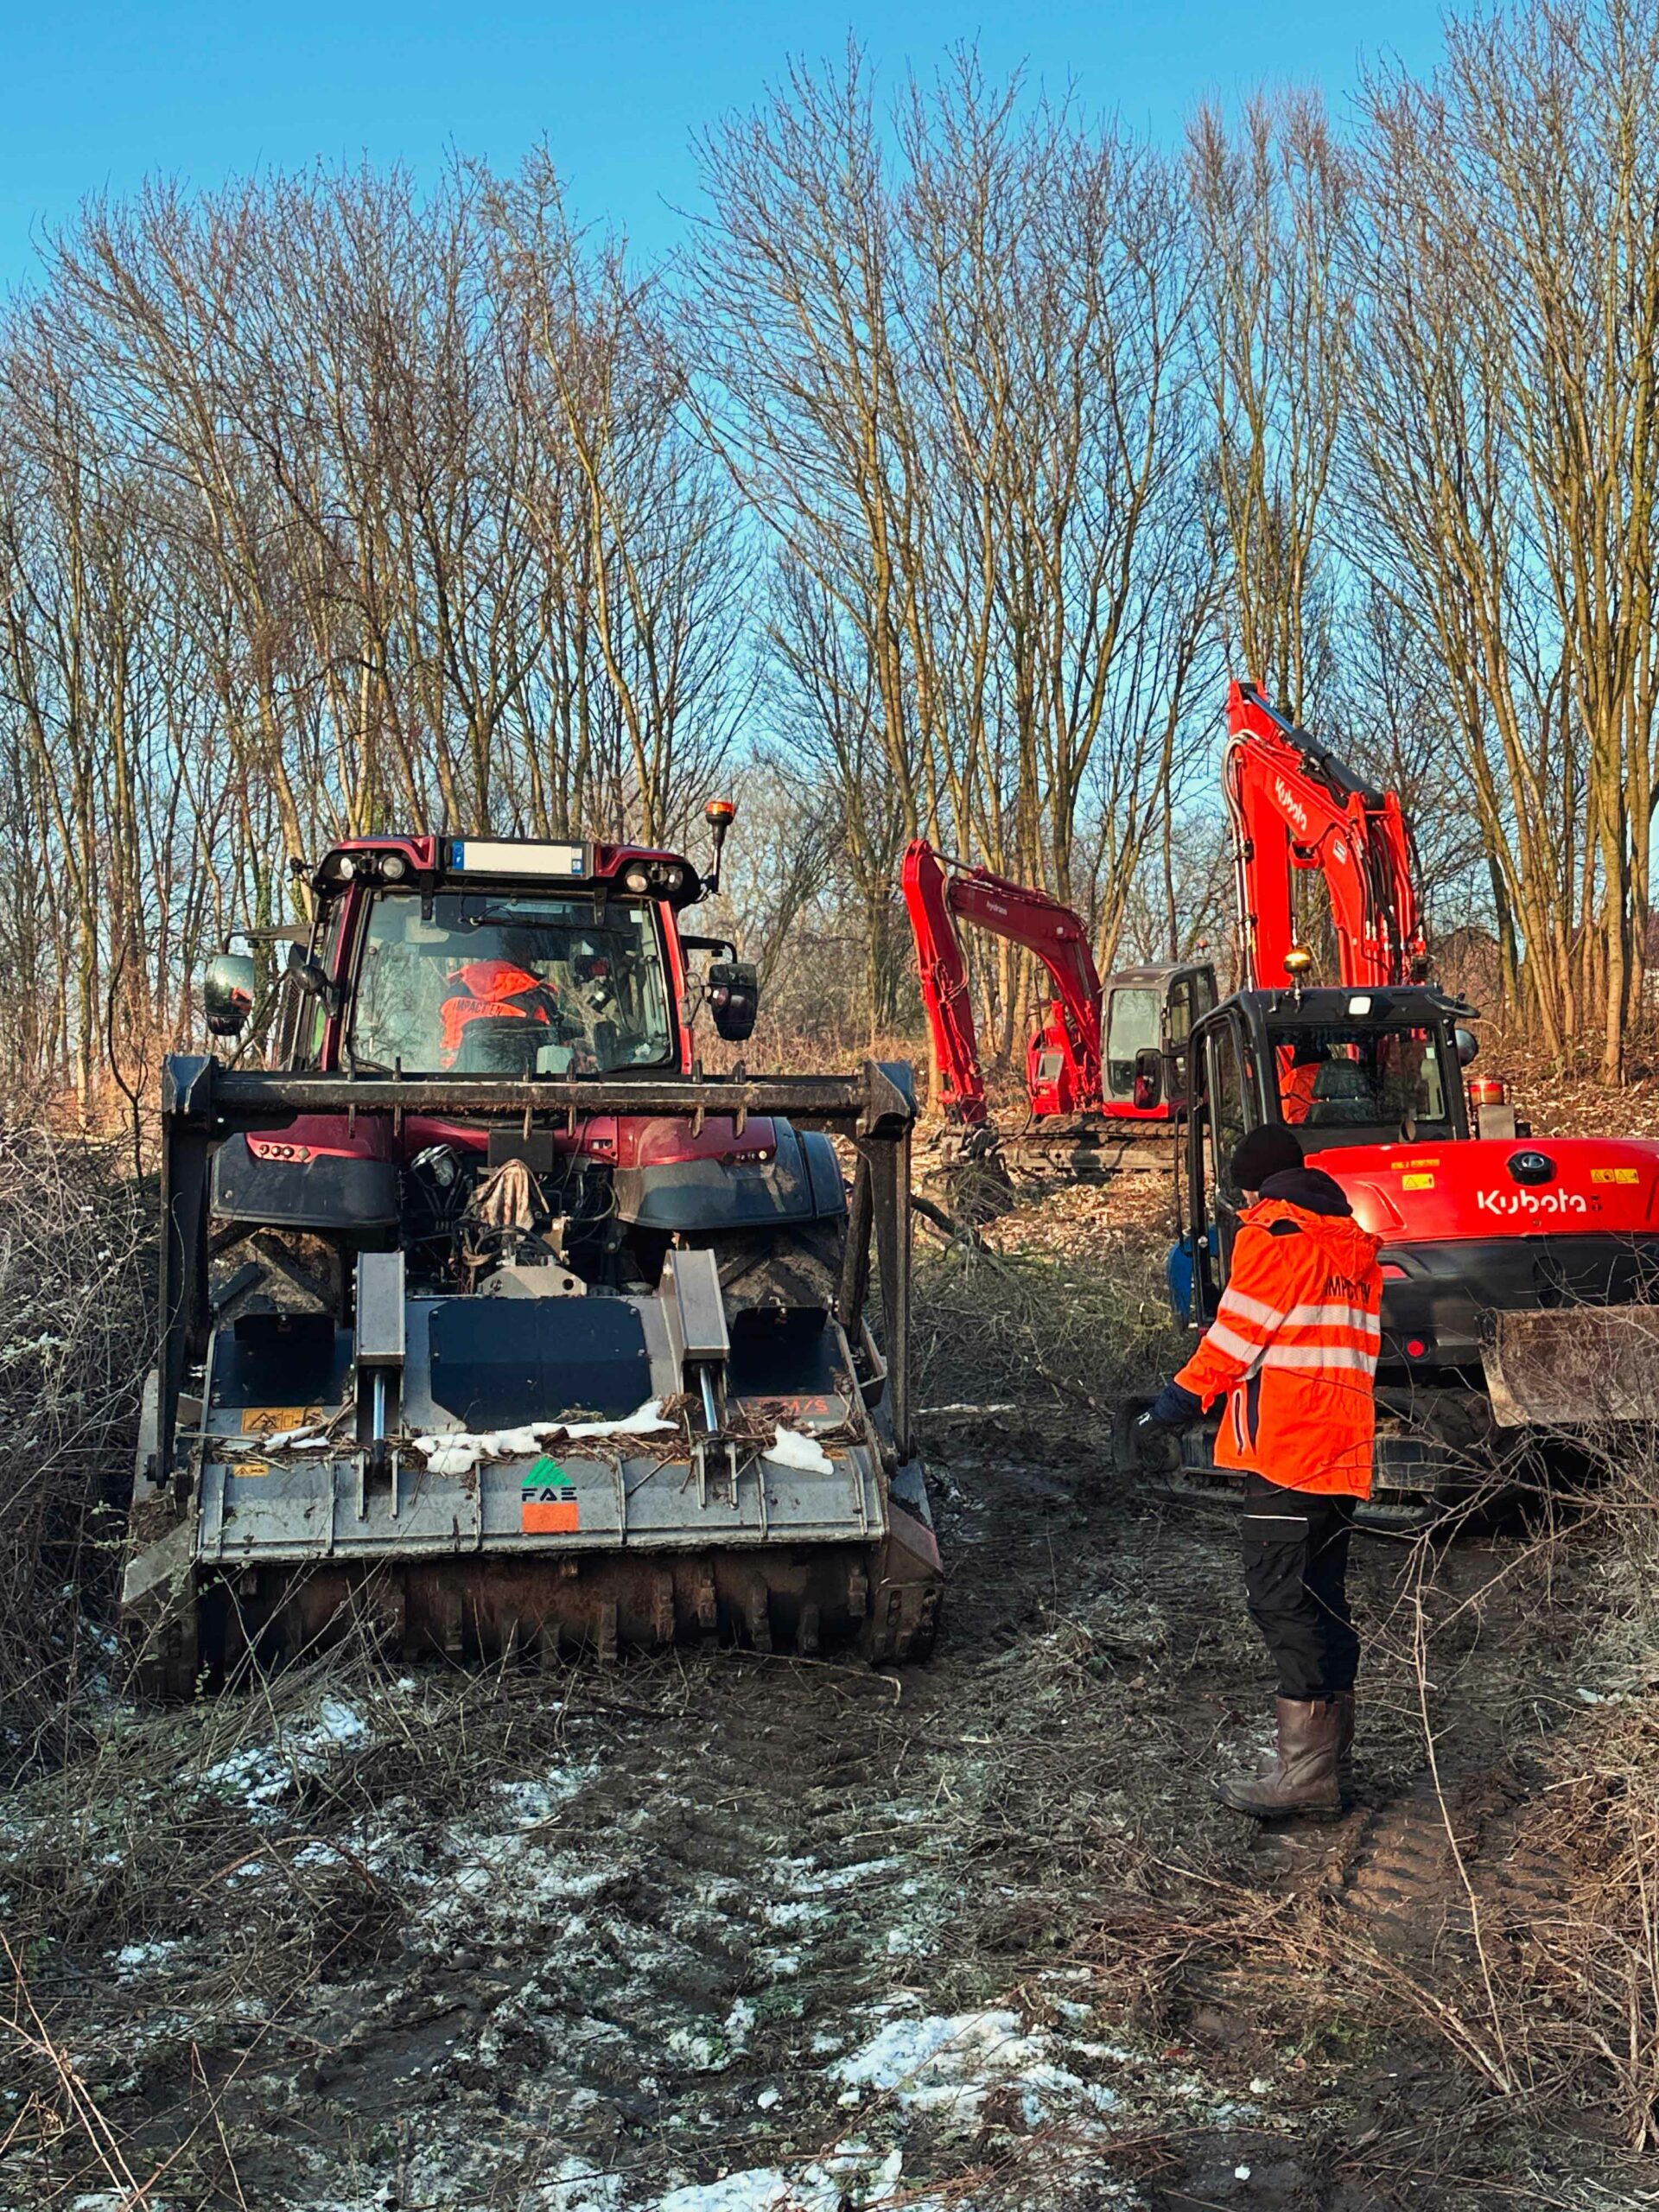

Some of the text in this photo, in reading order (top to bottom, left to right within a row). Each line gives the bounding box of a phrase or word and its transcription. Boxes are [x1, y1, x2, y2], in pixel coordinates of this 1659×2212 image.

[1275, 776, 1307, 831] Kubota
[1477, 1187, 1587, 1215] Kubota
[521, 1487, 577, 1502] FAE
